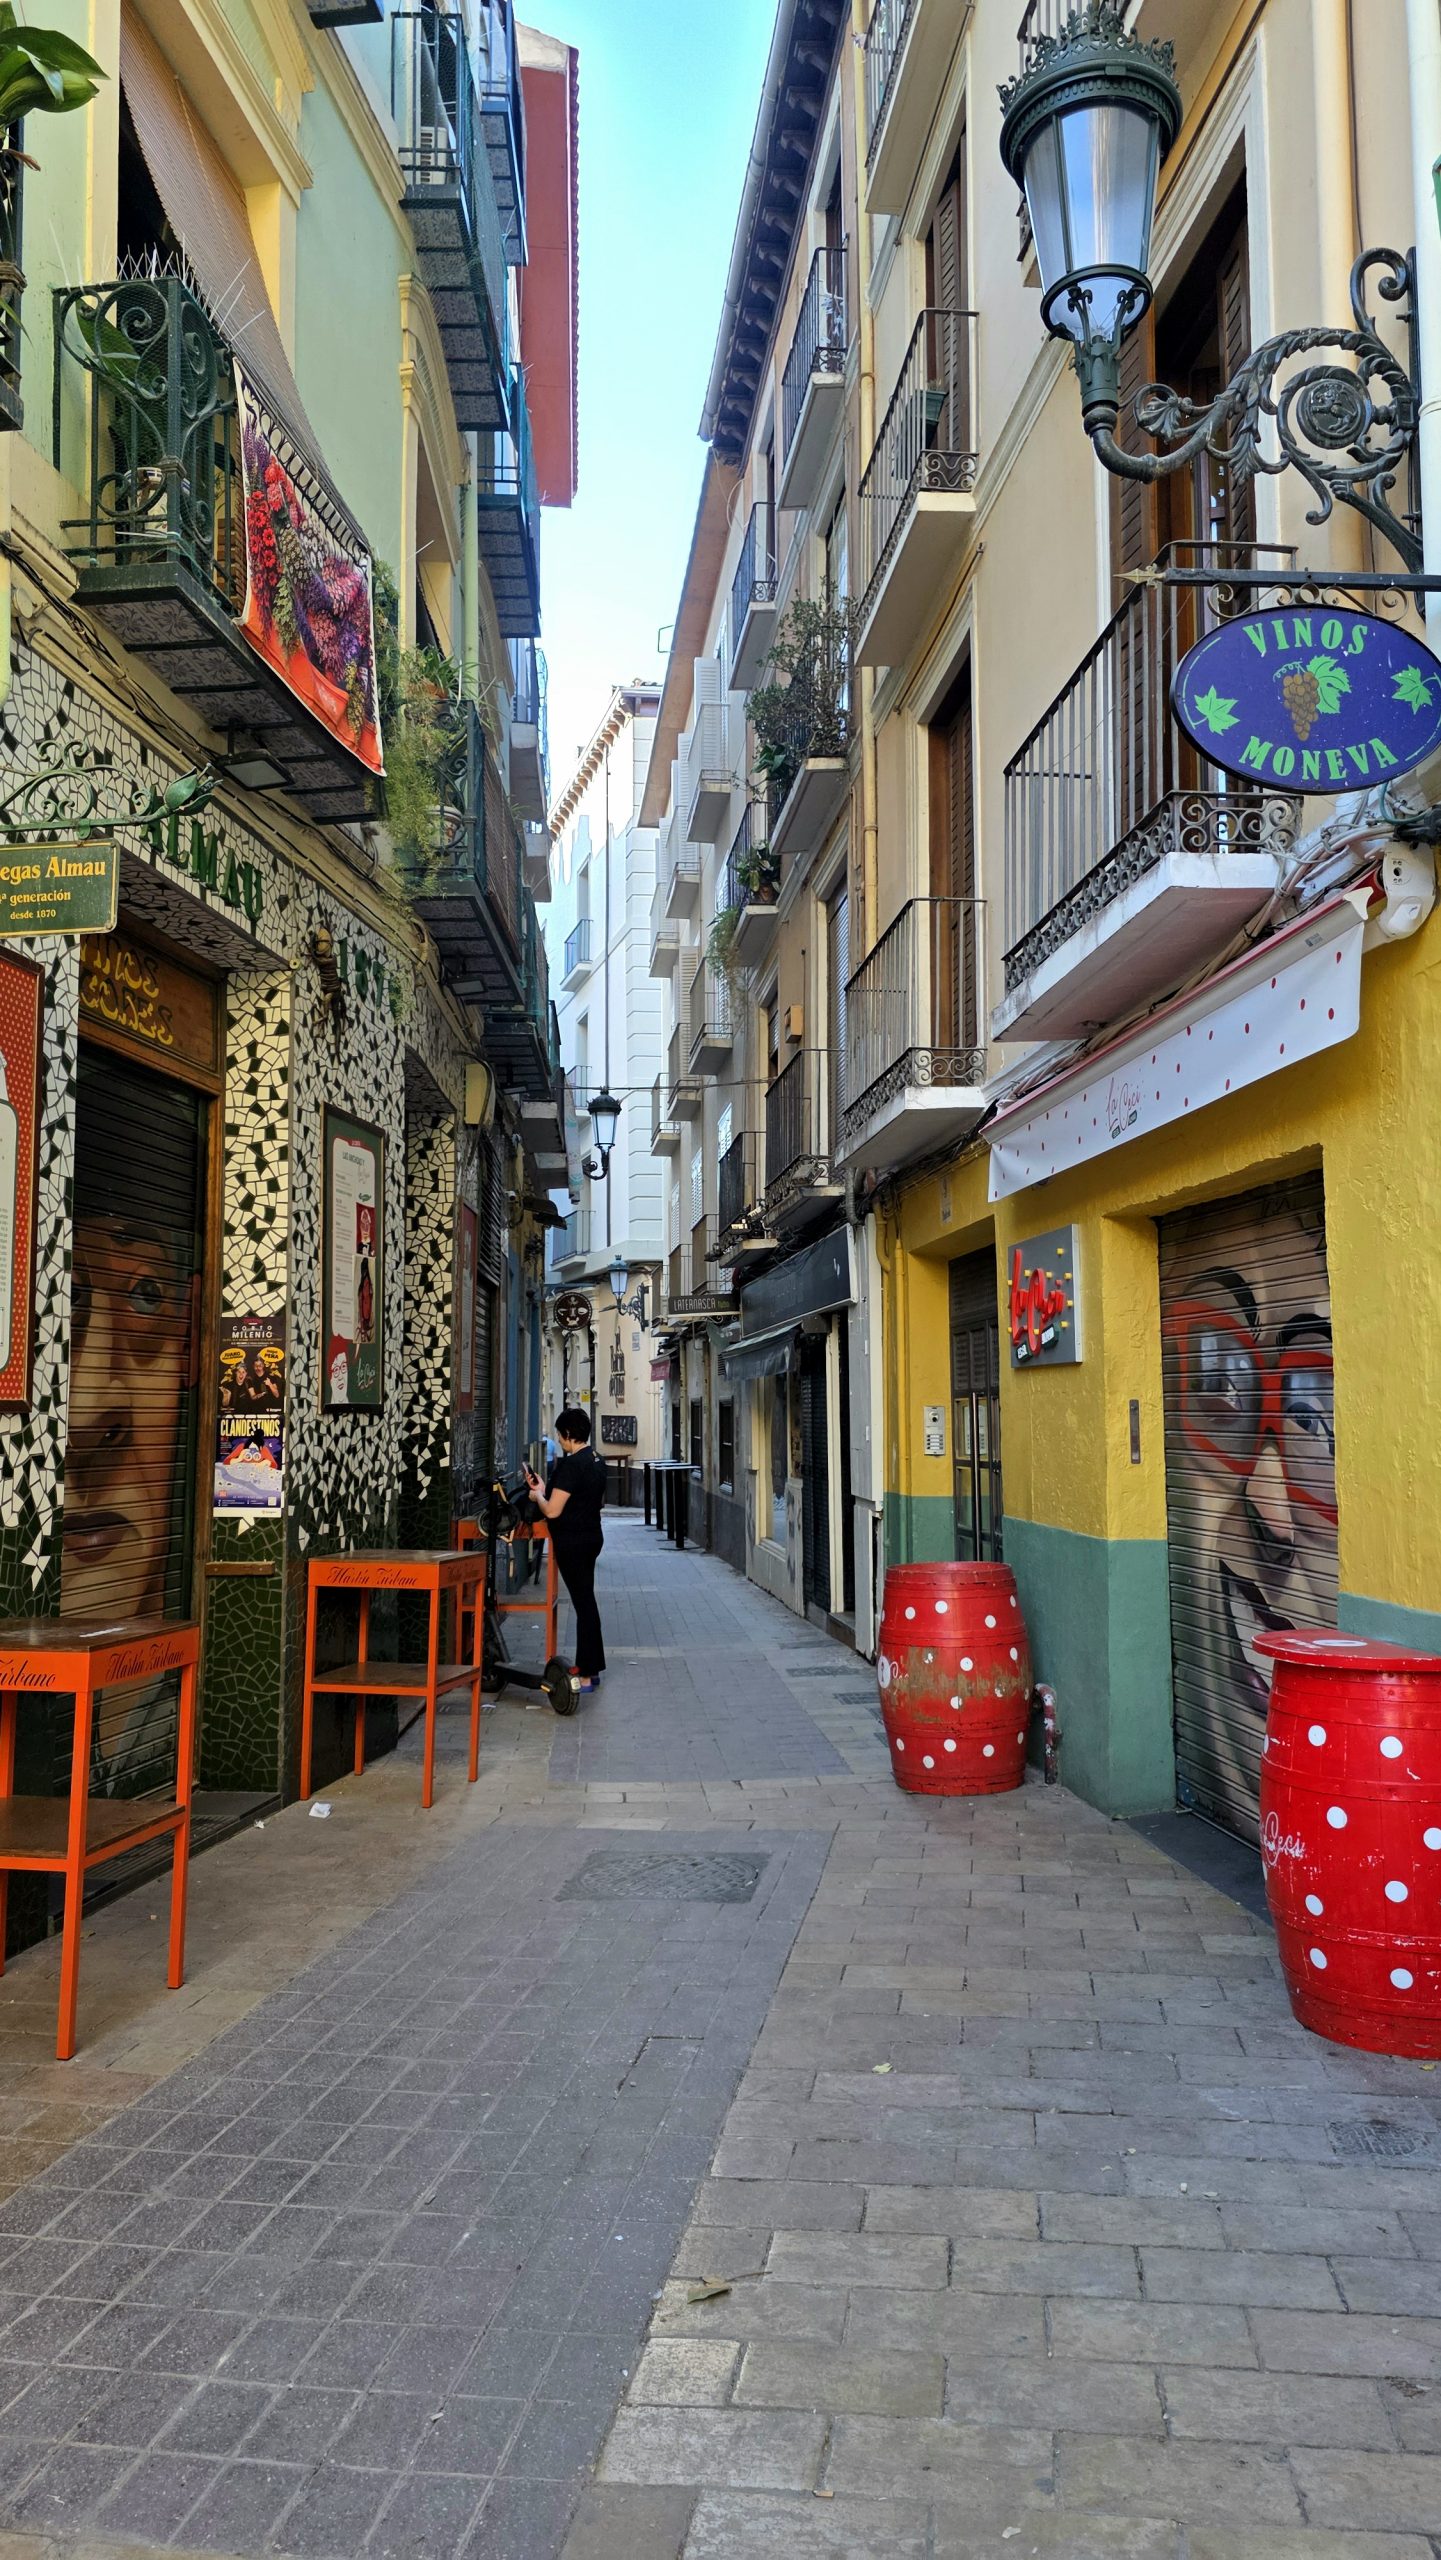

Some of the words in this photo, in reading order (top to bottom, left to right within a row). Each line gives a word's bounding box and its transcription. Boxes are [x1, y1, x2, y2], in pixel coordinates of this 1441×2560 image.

[1242, 617, 1368, 655] VINOS
[1238, 735, 1399, 781] MONEVA
[45, 856, 106, 878] Almau
[139, 784, 264, 922] ALMAU
[10, 889, 71, 906] generación
[10, 910, 33, 920] desde
[36, 909, 56, 918] 1870
[1105, 1077, 1119, 1132] La
[1119, 1082, 1141, 1131] Ceci
[220, 1419, 280, 1437] CLANDESTINOS
